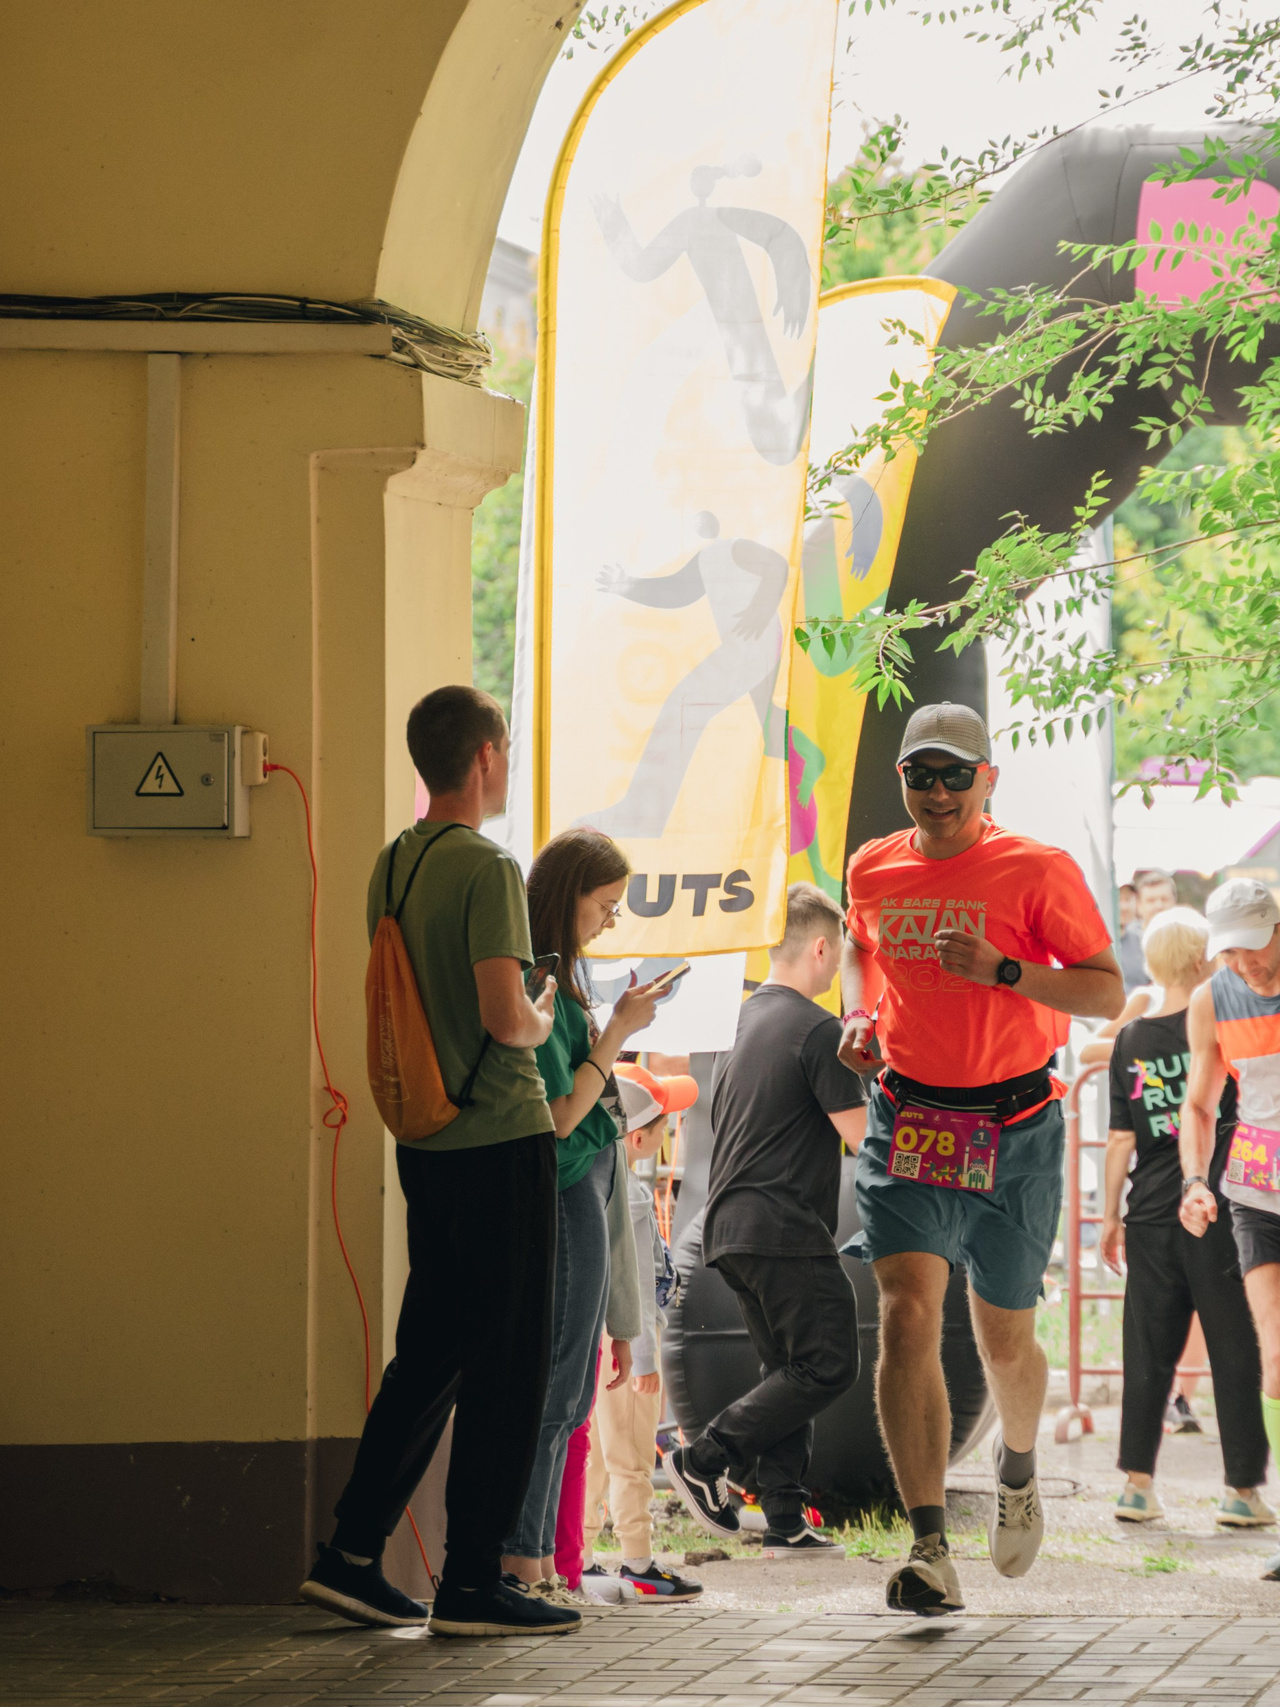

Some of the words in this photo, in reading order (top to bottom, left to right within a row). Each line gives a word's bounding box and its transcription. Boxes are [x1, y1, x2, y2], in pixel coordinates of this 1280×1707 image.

[880, 897, 899, 908] AK
[902, 898, 941, 908] BARS
[945, 899, 988, 911] BANK
[879, 908, 986, 944] KAZAN
[895, 1126, 956, 1157] 078
[978, 1132, 985, 1141] 1
[1231, 1138, 1268, 1166] 264
